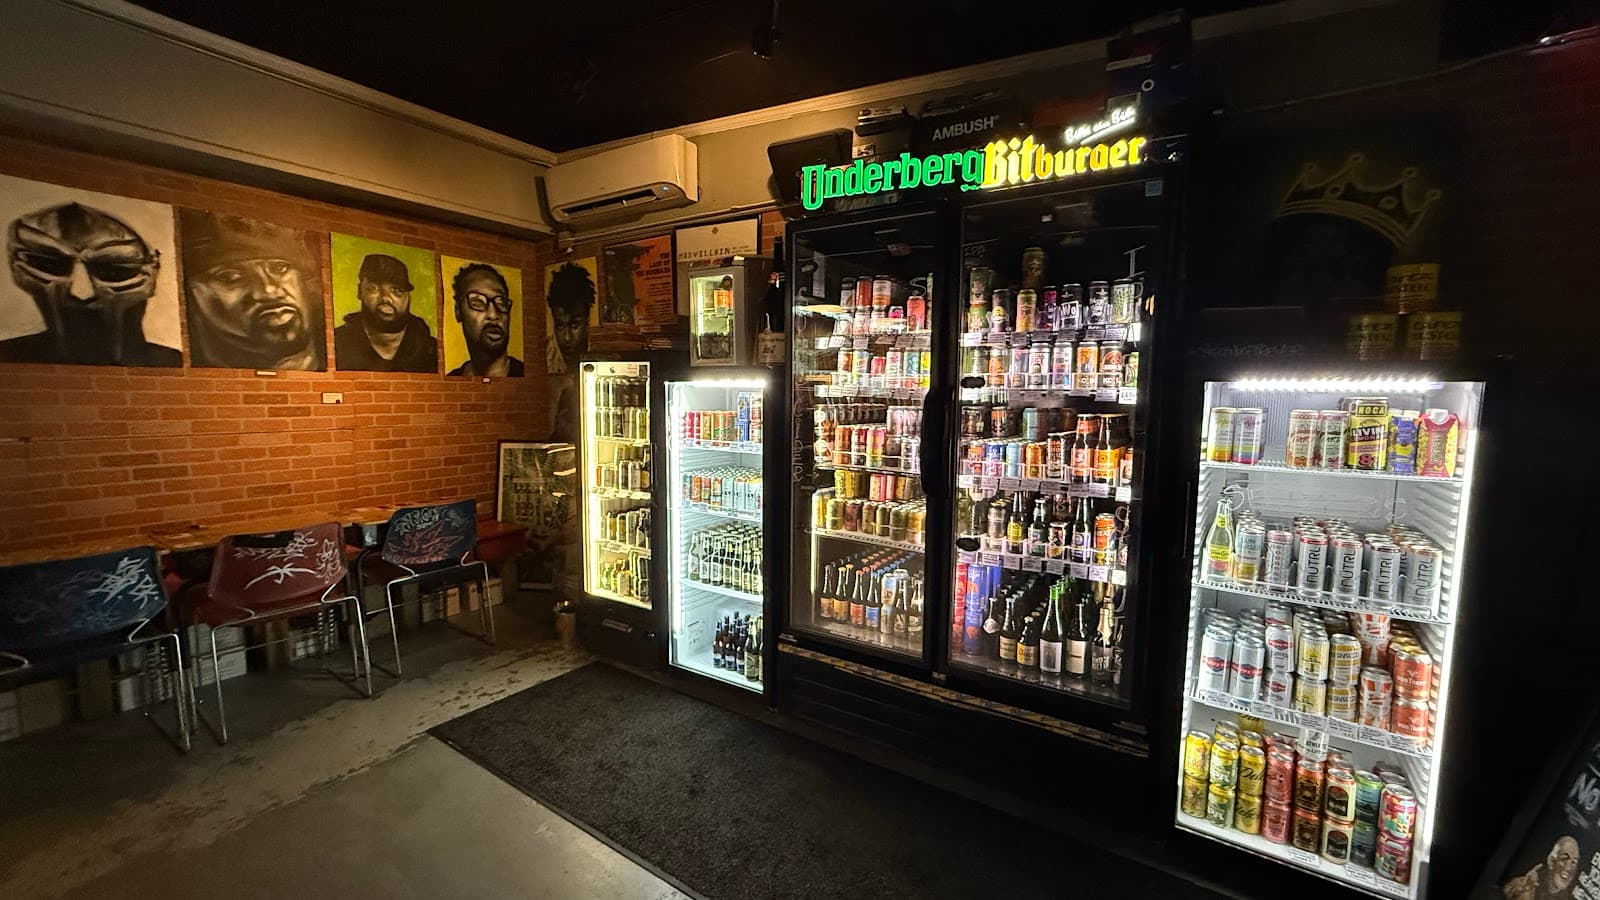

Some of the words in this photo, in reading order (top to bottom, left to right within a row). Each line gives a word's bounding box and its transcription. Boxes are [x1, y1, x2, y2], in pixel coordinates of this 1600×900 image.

[932, 117, 994, 142] AMBUSH
[801, 149, 984, 211] Underberg
[1358, 406, 1386, 415] NOCA
